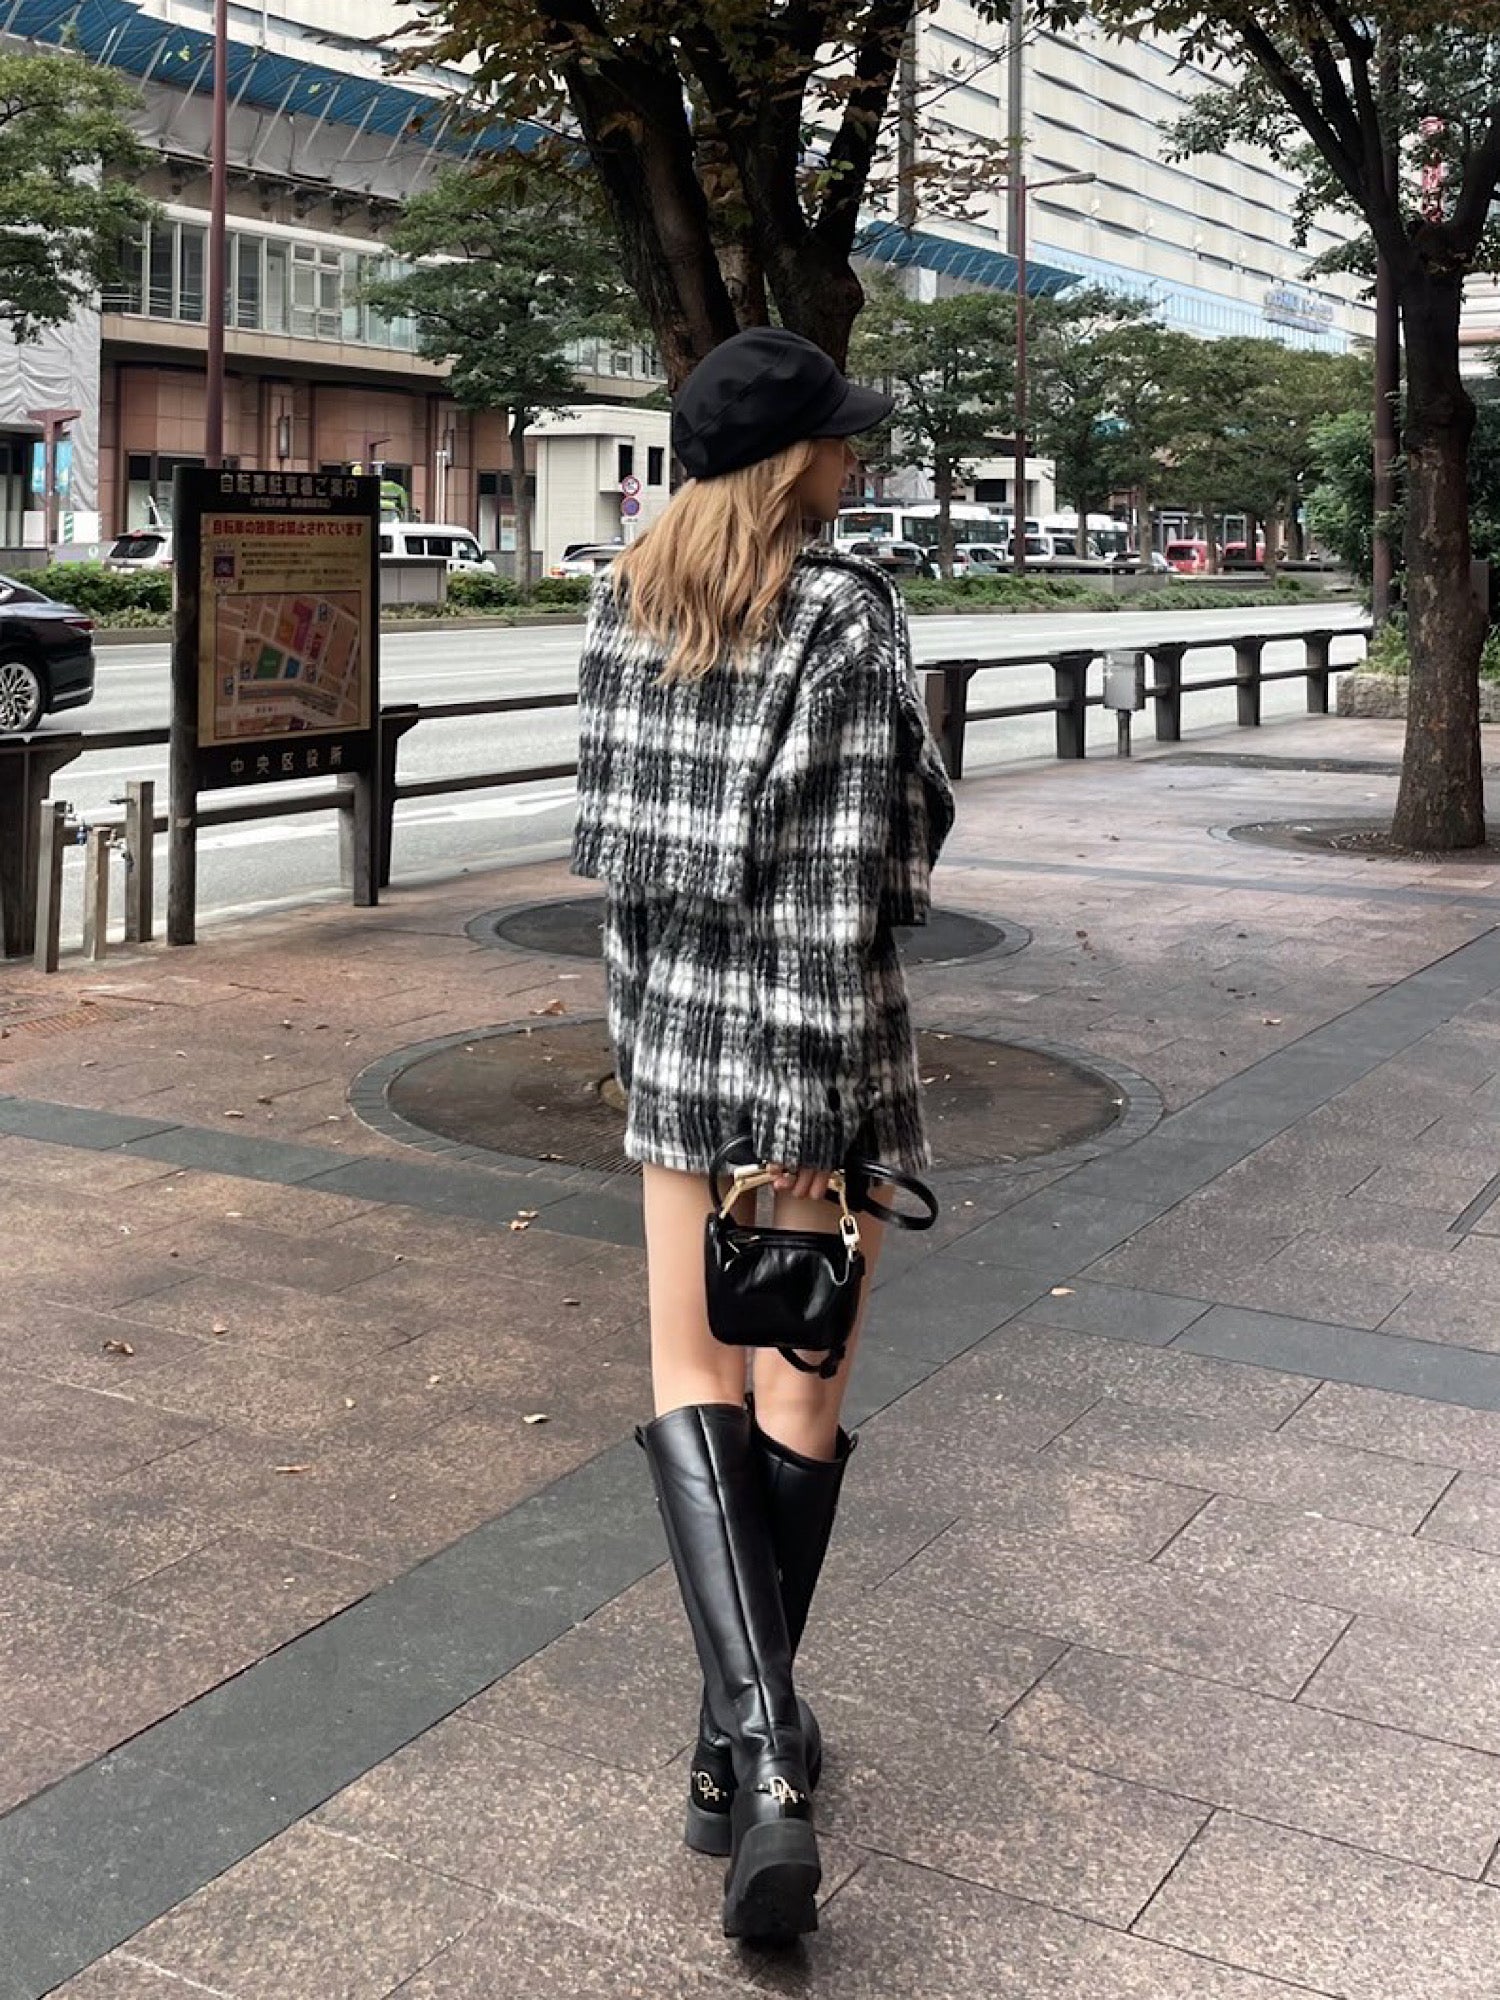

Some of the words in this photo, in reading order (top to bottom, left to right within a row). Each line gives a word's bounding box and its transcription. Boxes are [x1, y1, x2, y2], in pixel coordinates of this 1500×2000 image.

[213, 519, 363, 536] 自転車の放置は禁止されています
[230, 744, 343, 776] 中央区役所
